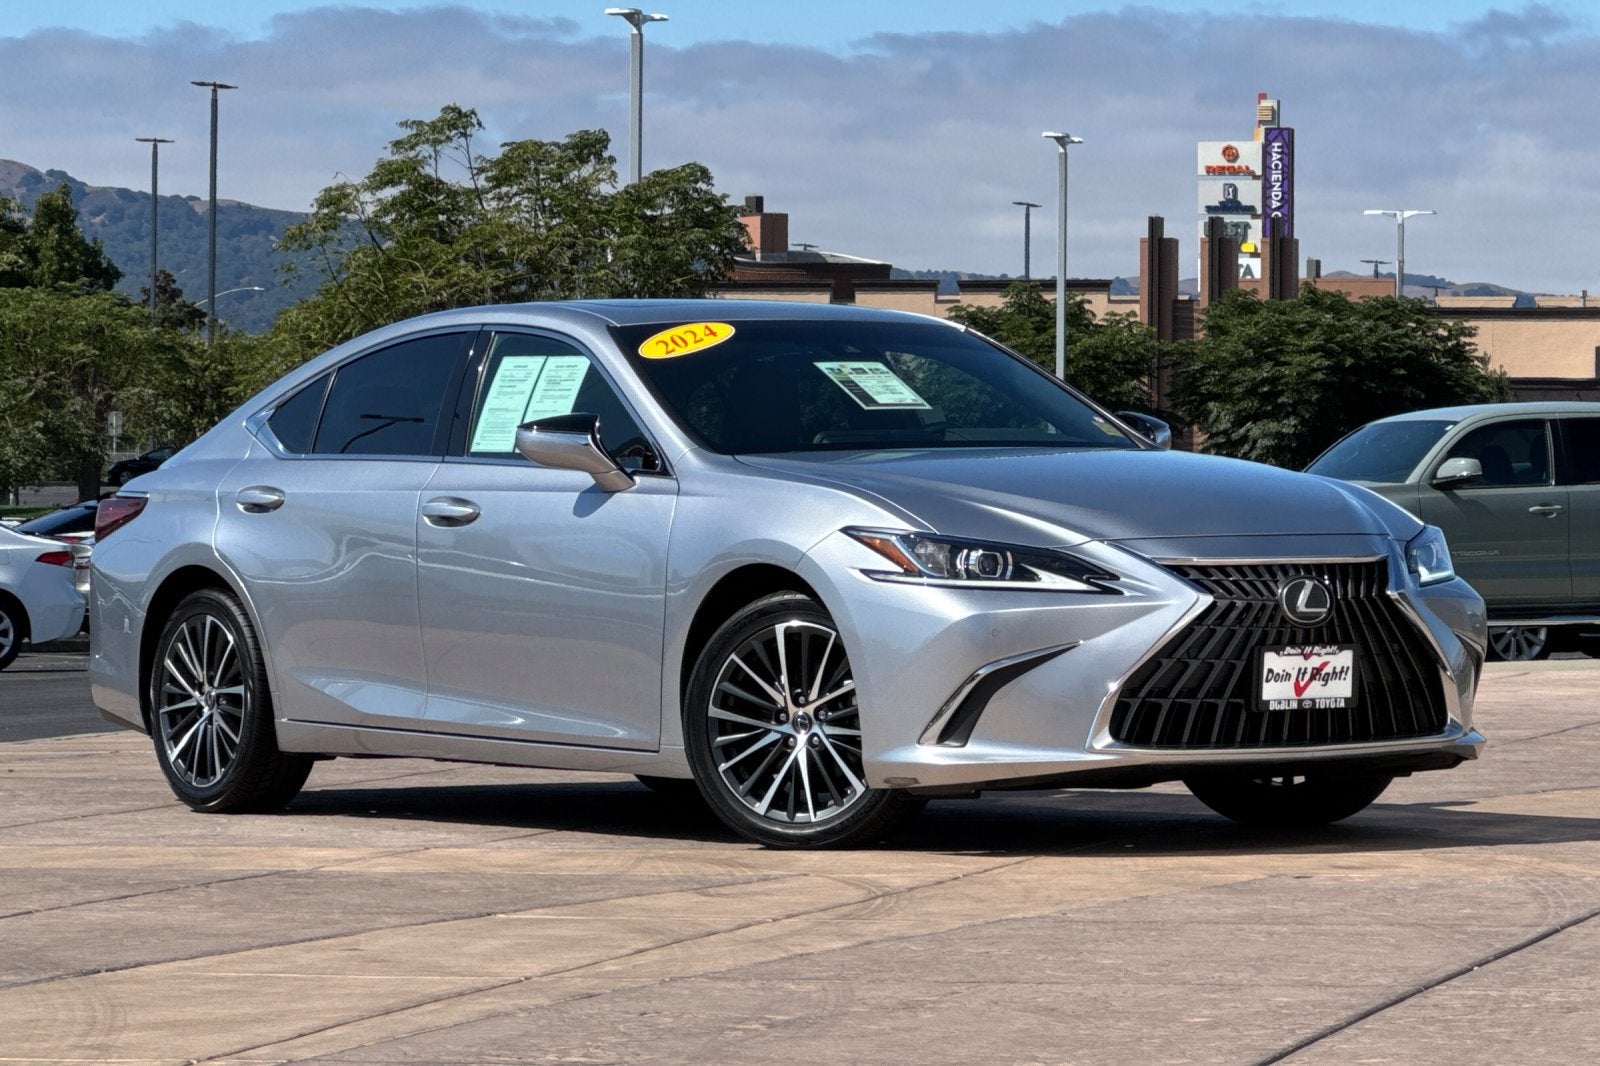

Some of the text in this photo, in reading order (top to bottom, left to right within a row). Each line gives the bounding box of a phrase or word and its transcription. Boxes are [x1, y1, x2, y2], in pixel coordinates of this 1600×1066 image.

[1205, 165, 1254, 175] REGAL
[1271, 142, 1283, 209] HACIENDA
[655, 325, 718, 355] 2024
[1265, 666, 1350, 687] Doin' It Right!
[1269, 698, 1345, 711] DUBLIN TOYOTA
